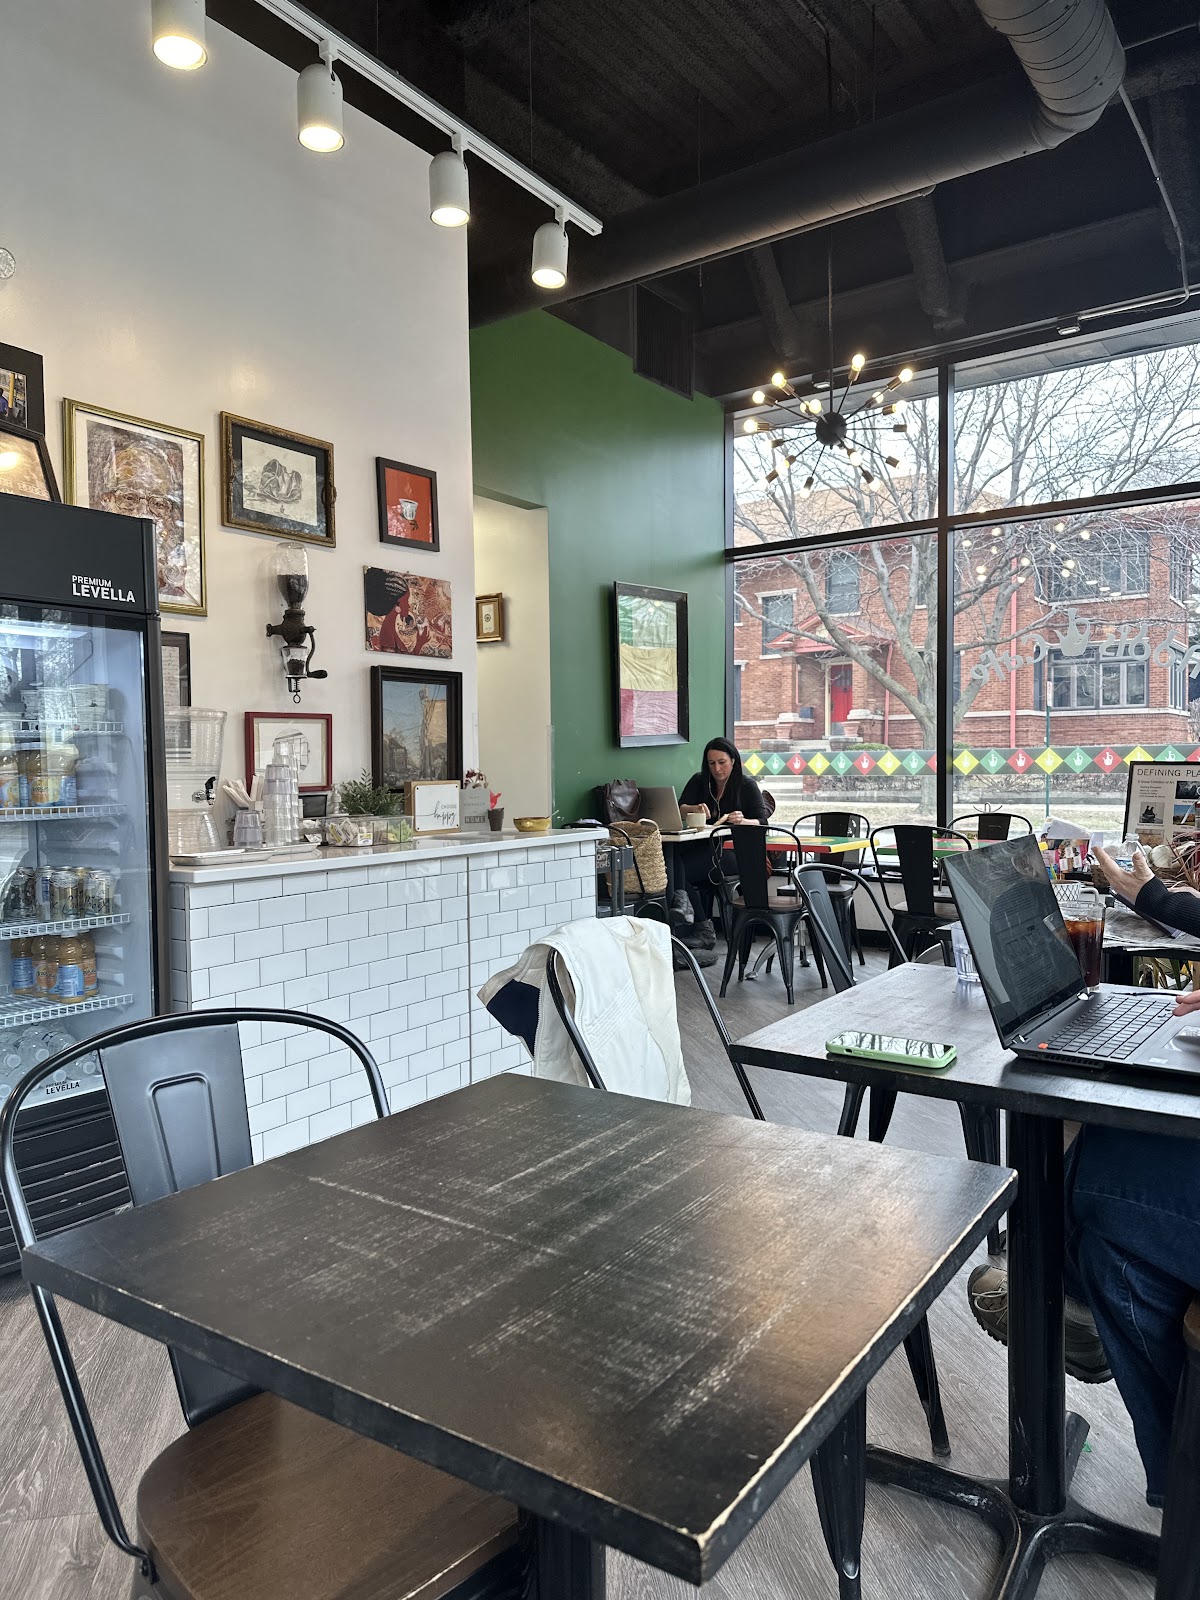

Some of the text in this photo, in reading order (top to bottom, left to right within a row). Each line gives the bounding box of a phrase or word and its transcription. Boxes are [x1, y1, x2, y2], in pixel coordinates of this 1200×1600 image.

[72, 575, 112, 588] PREMIUM
[72, 583, 136, 602] LEVELLA
[1137, 768, 1181, 776] DEFINING
[46, 1081, 80, 1095] LEVELLA
